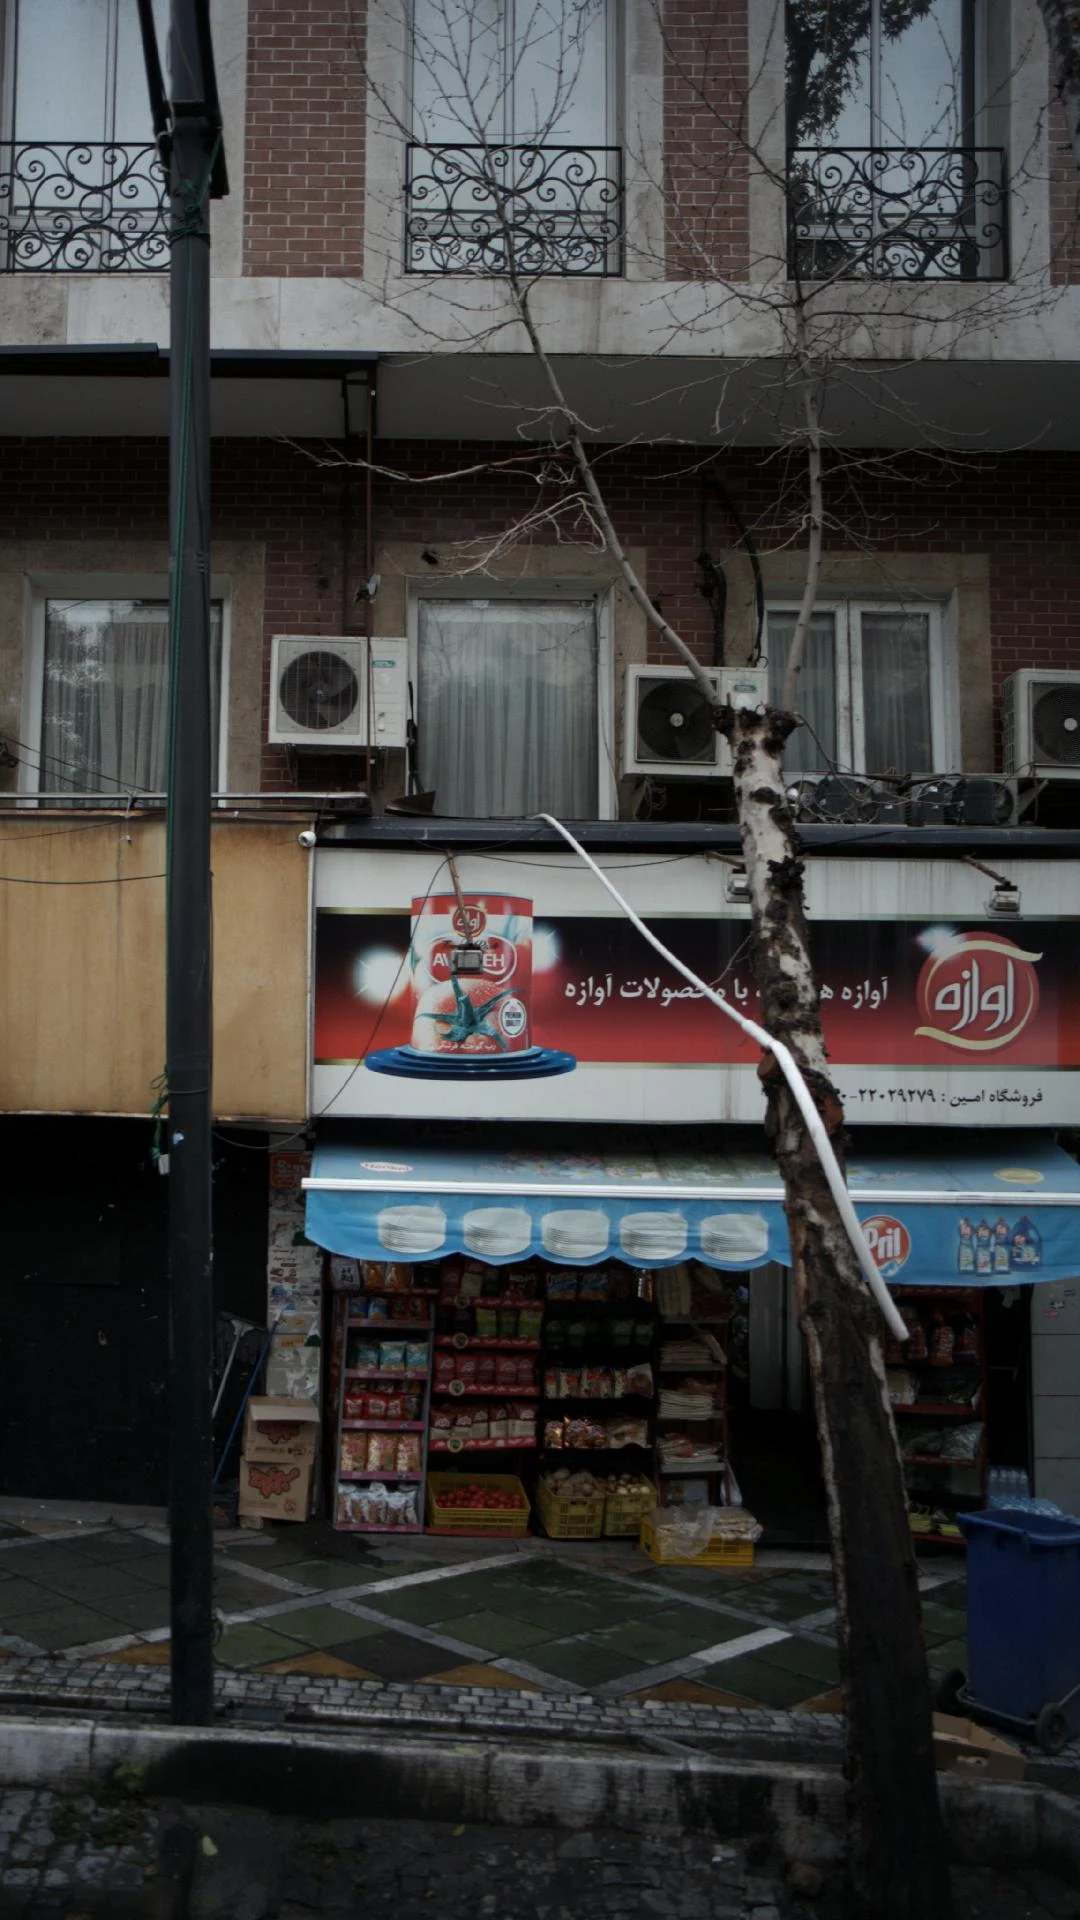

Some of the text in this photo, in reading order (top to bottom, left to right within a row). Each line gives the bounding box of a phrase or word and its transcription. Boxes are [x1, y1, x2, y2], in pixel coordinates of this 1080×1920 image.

[432, 952, 505, 968] AVEH
[733, 977, 749, 1006] با
[935, 958, 1015, 1032] اوازه
[988, 1087, 1043, 1108] فروشگاه
[863, 1226, 902, 1260] Pril
